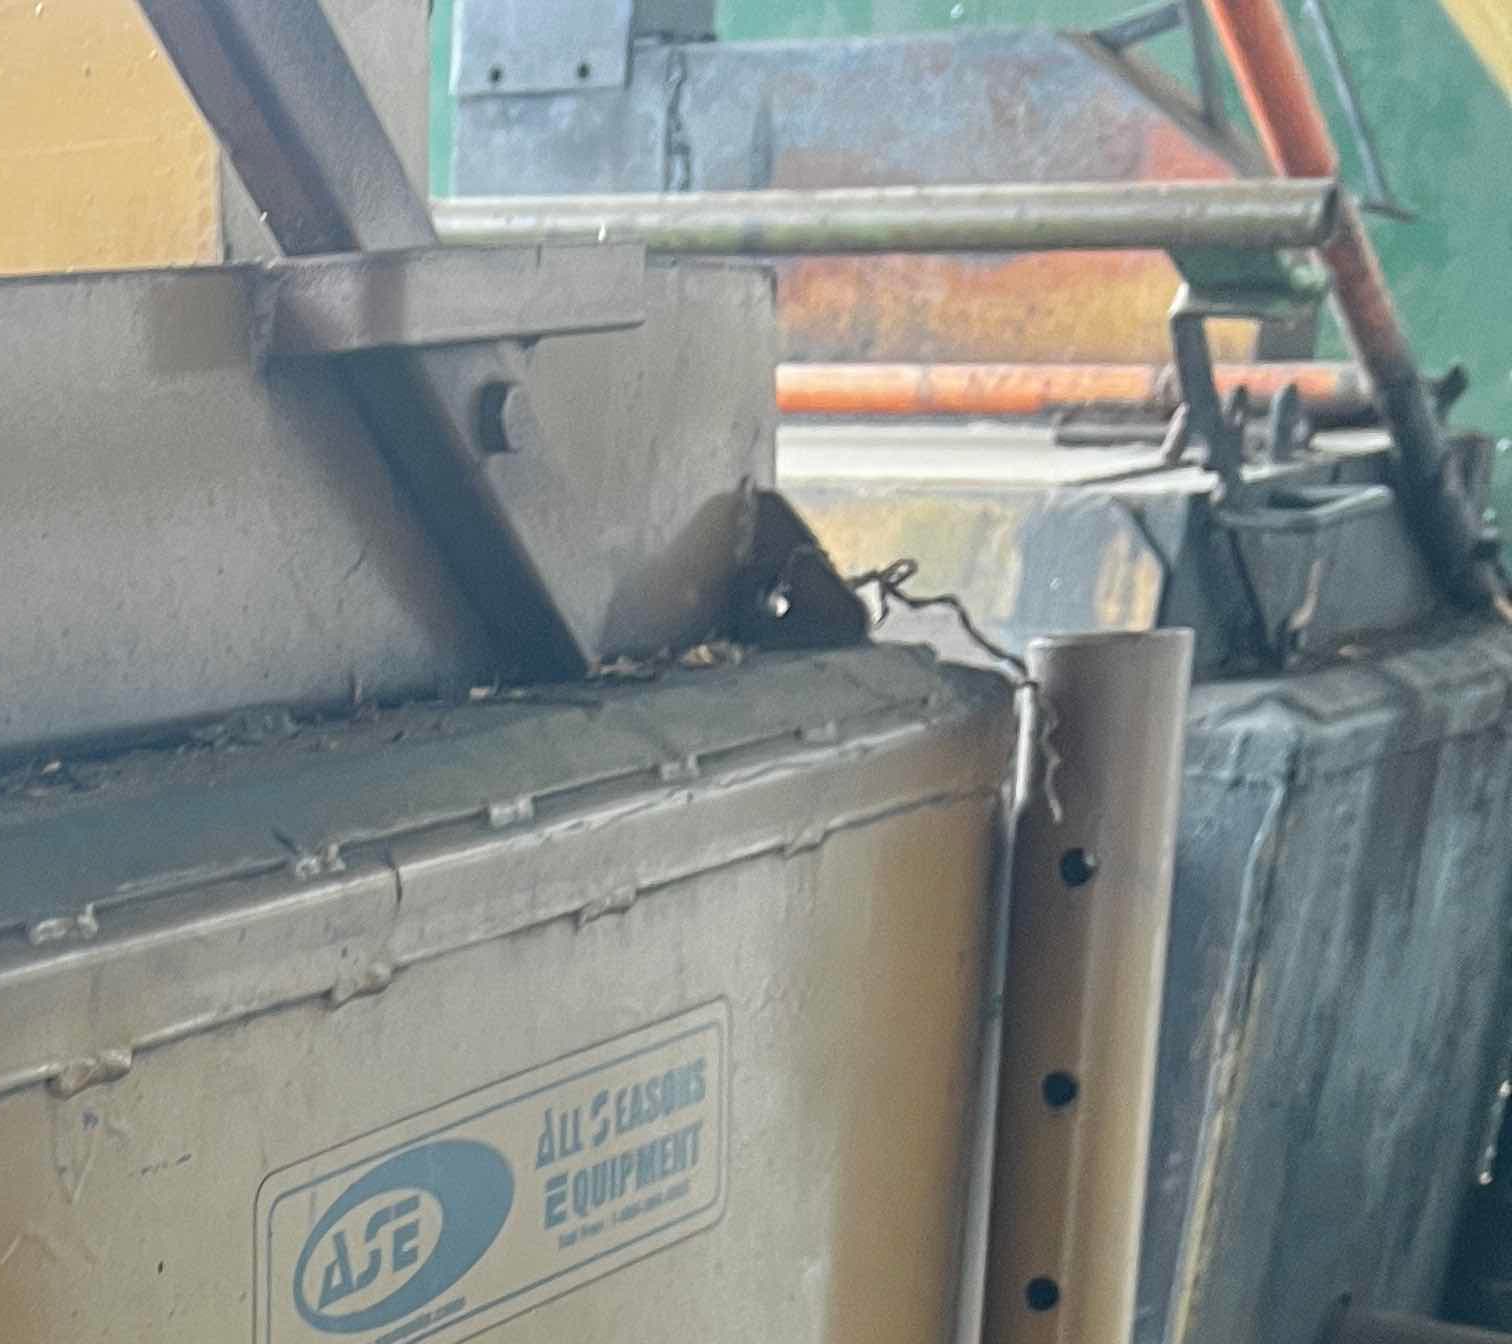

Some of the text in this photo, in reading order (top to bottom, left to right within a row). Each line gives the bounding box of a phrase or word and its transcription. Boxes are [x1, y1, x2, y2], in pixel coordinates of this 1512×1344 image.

[535, 1056, 707, 1171] ALL SEASONS
[544, 1119, 703, 1231] EQUIPMENT
[316, 1194, 422, 1312] ASE
